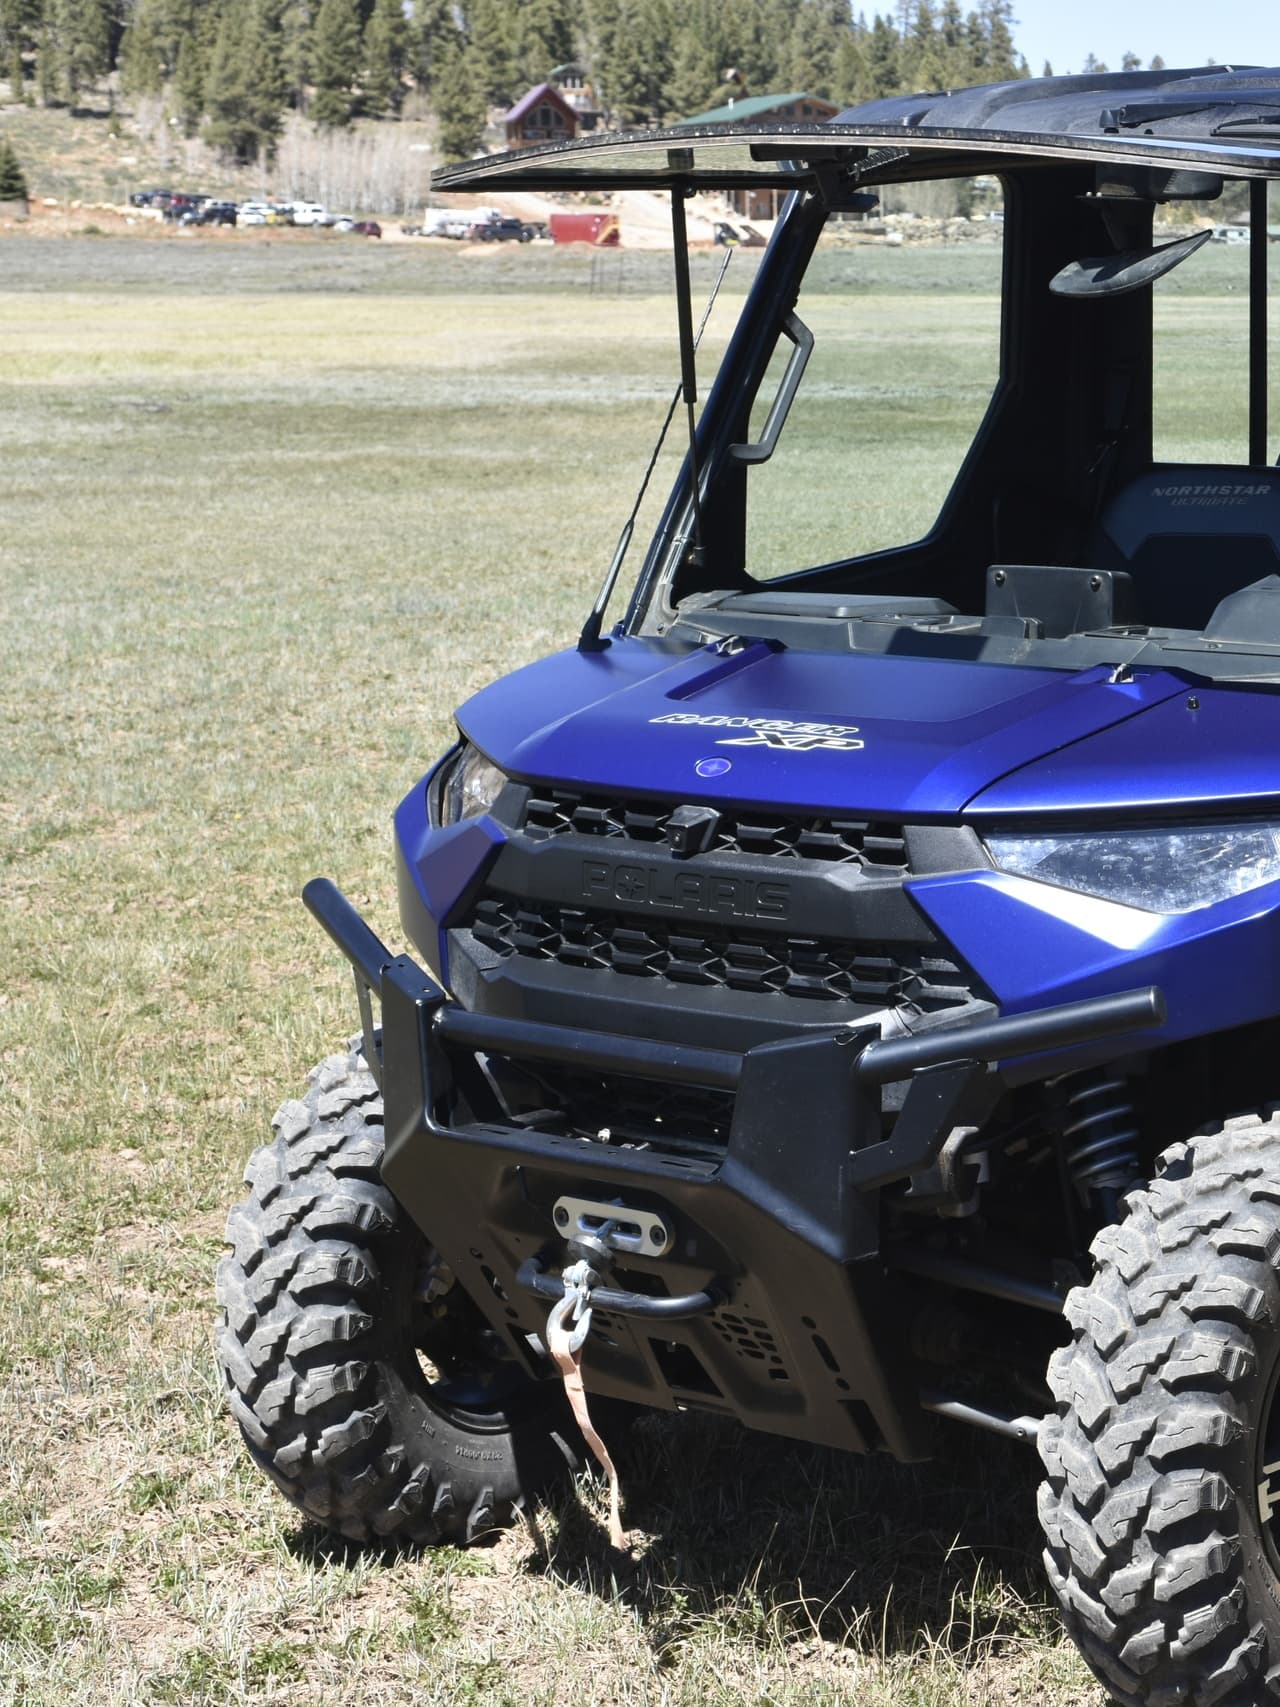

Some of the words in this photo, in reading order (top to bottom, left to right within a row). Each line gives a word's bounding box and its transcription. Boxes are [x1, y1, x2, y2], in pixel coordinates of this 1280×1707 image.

[1151, 484, 1272, 497] NORTHSTAR
[648, 713, 860, 737] RANGER
[714, 729, 865, 751] XP
[581, 859, 792, 921] POLARIS
